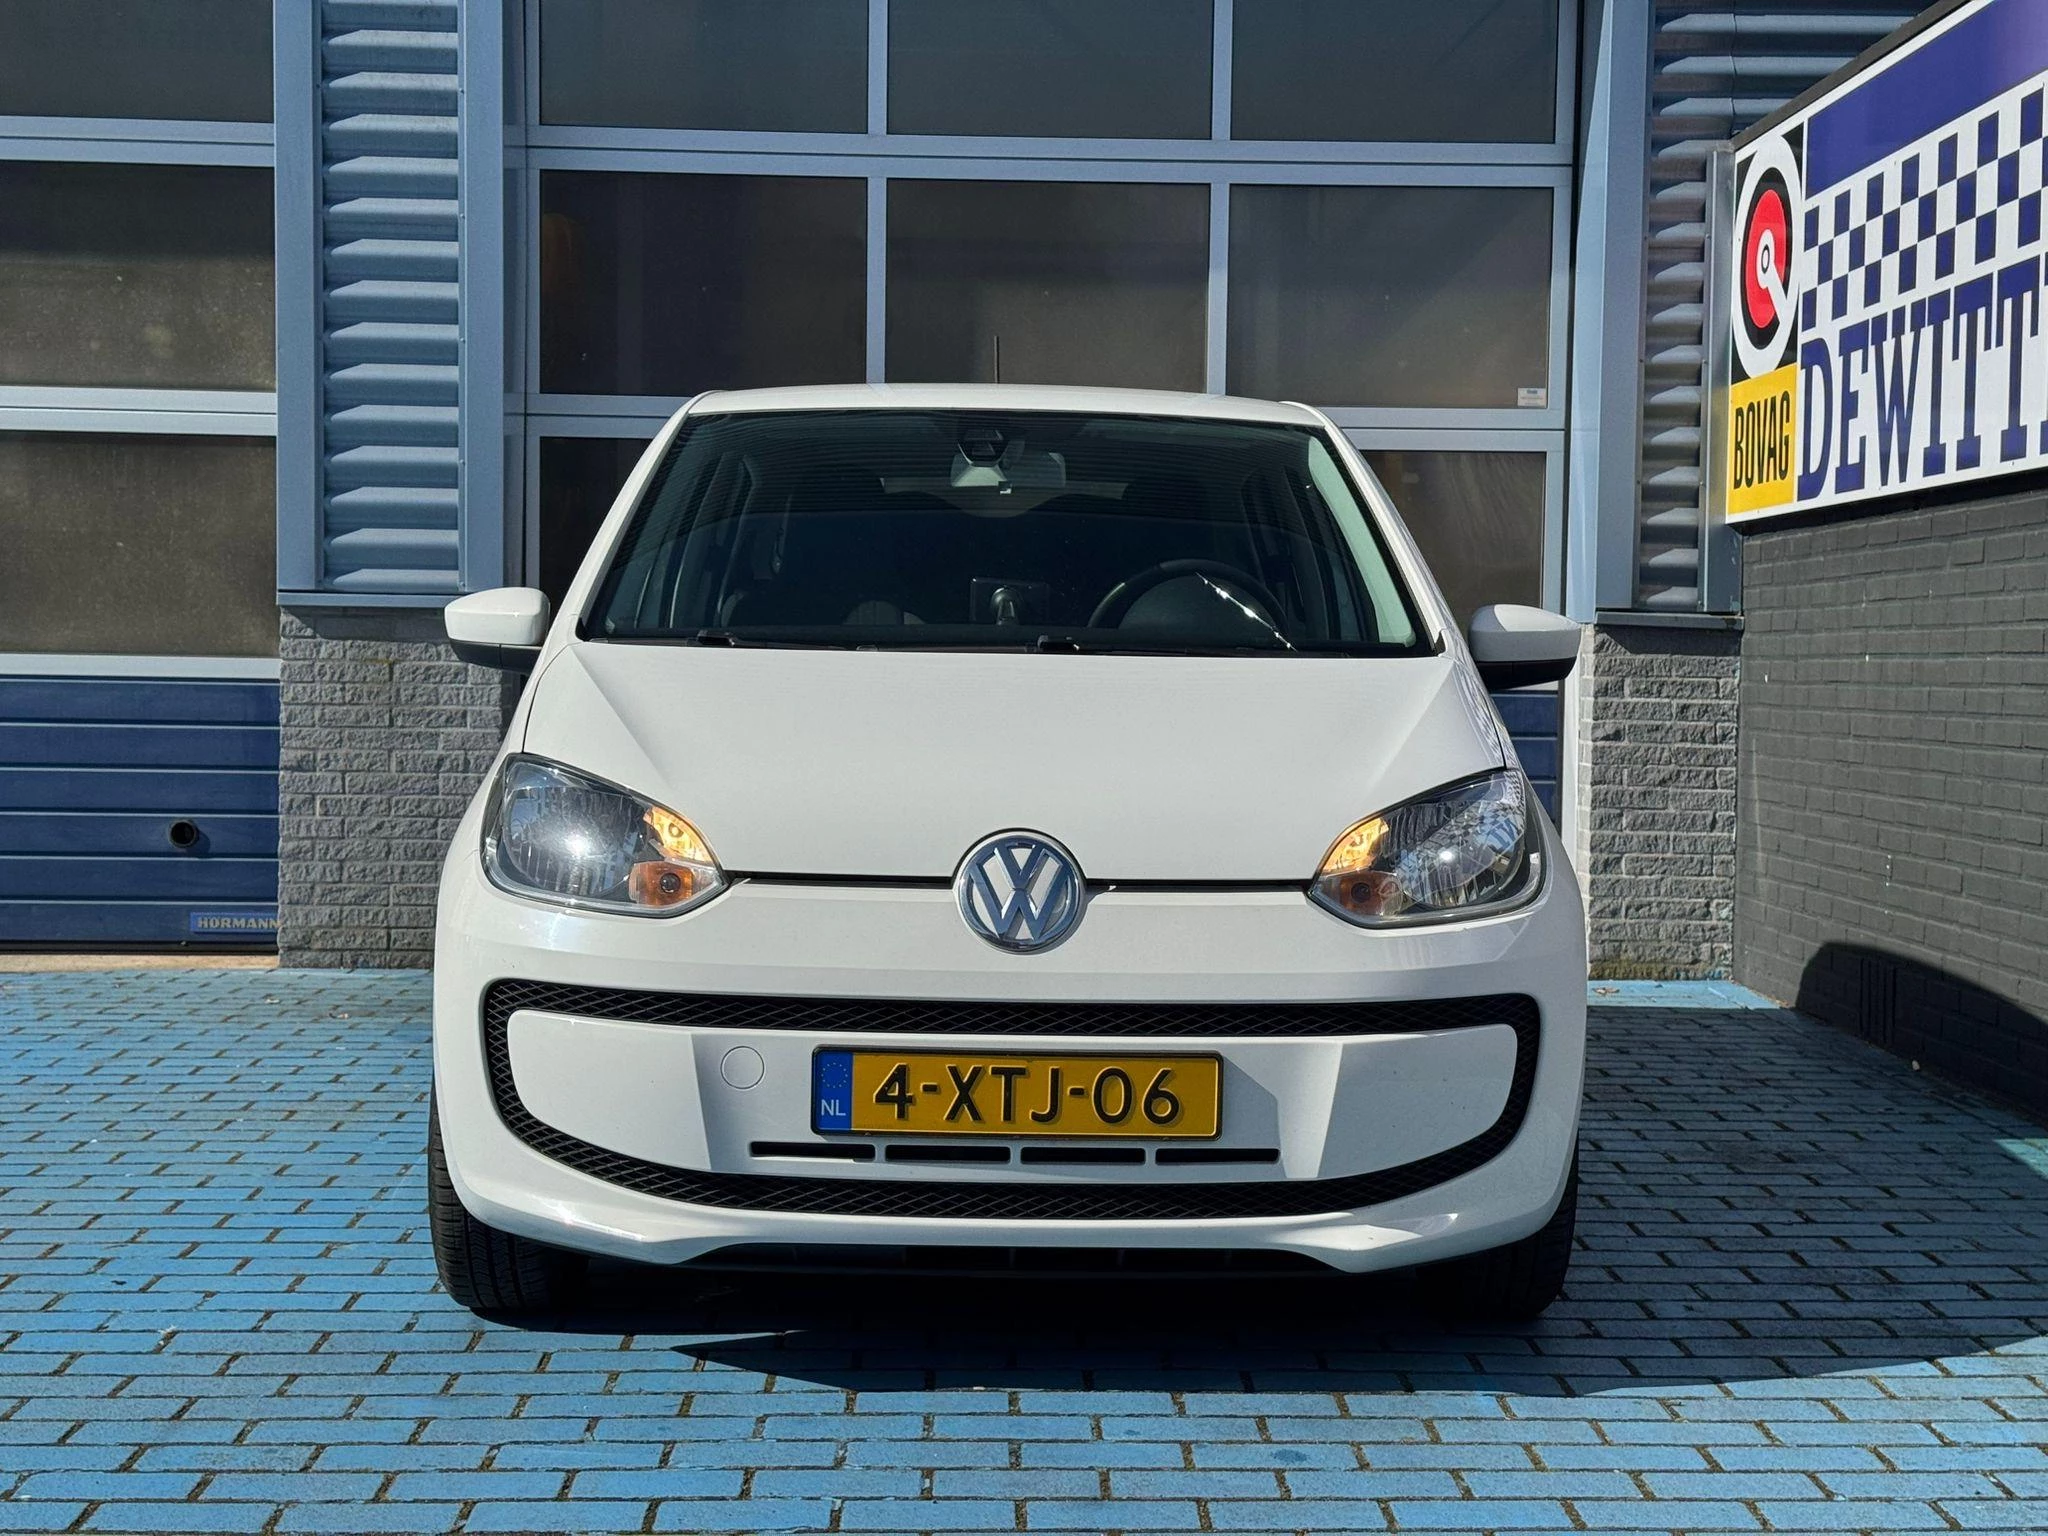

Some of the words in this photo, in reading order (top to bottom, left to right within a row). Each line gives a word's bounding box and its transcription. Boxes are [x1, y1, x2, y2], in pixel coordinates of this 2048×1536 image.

[1797, 252, 2048, 501] DEWITT
[1733, 391, 1790, 490] BOVAG
[820, 1098, 846, 1116] NL
[873, 1063, 1181, 1125] 4-XTJ-06
